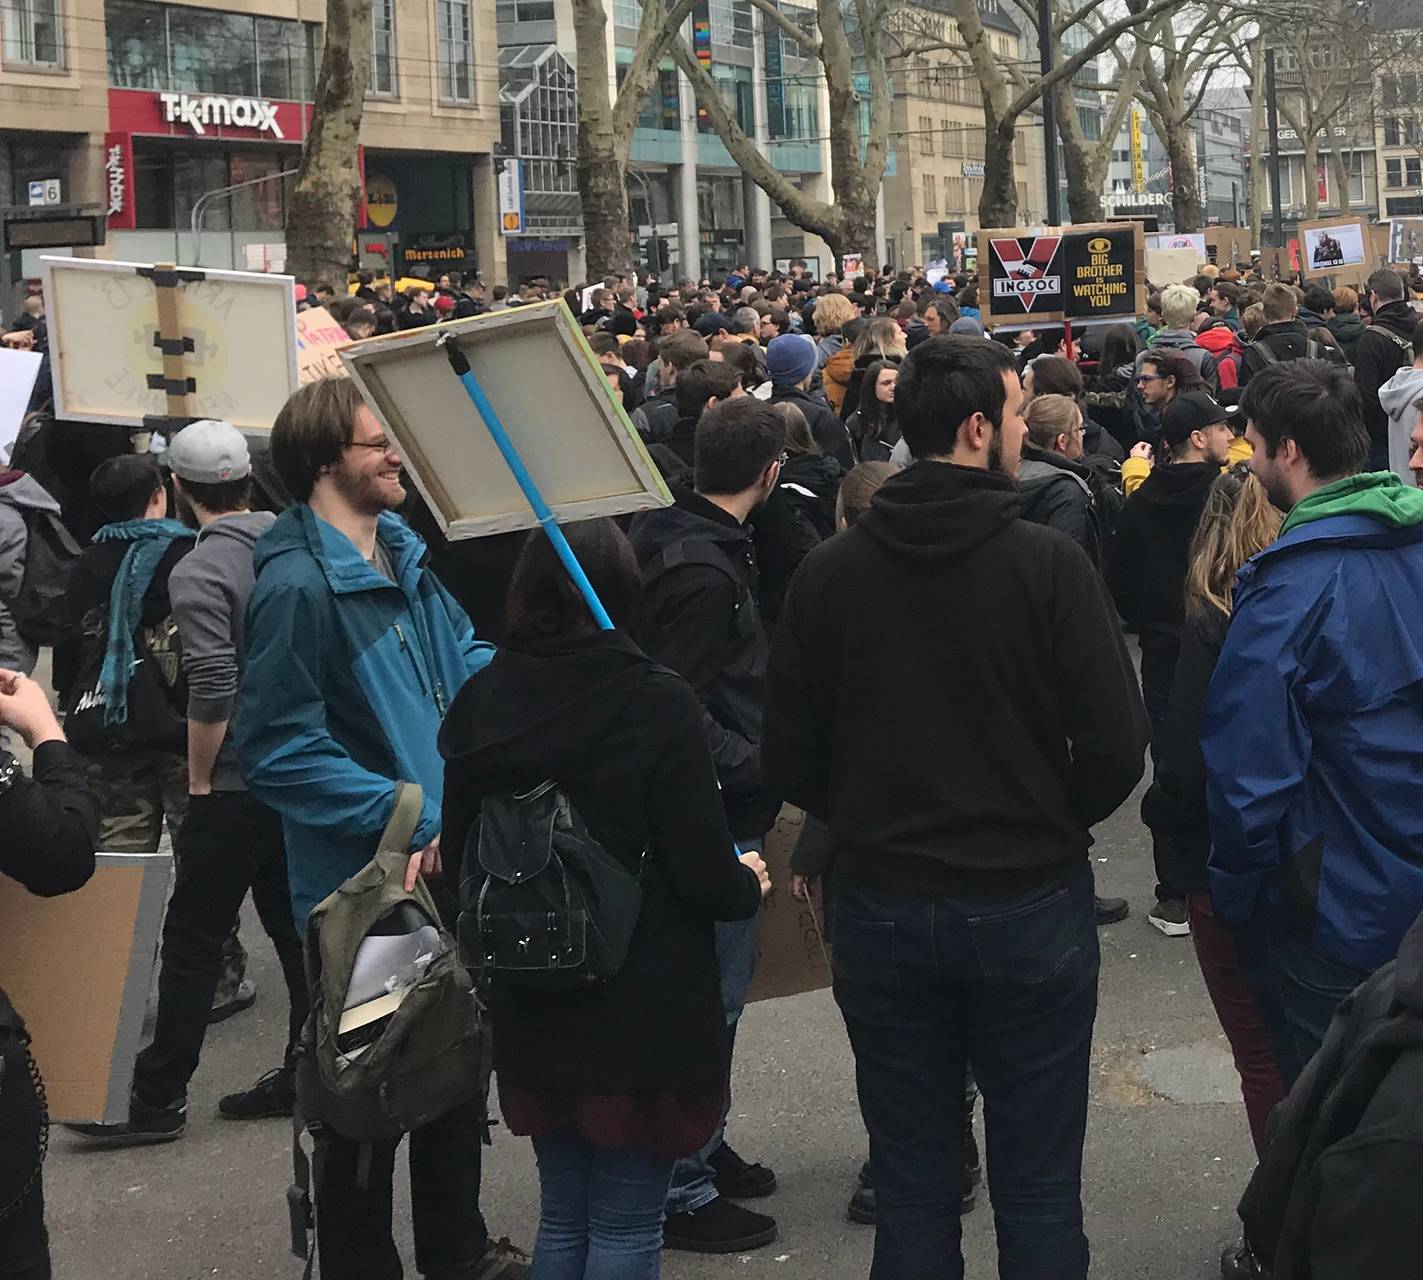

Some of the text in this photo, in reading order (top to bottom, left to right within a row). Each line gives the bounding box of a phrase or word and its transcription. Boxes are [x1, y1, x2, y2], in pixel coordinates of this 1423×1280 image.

[48, 186, 57, 200] 6
[1100, 192, 1174, 207] SCHILDERG
[1091, 254, 1109, 265] BIG
[1076, 264, 1123, 278] BROTHER
[1001, 279, 1055, 293] INGSOC
[1073, 282, 1127, 297] WATCHING
[1089, 295, 1111, 307] YOU
